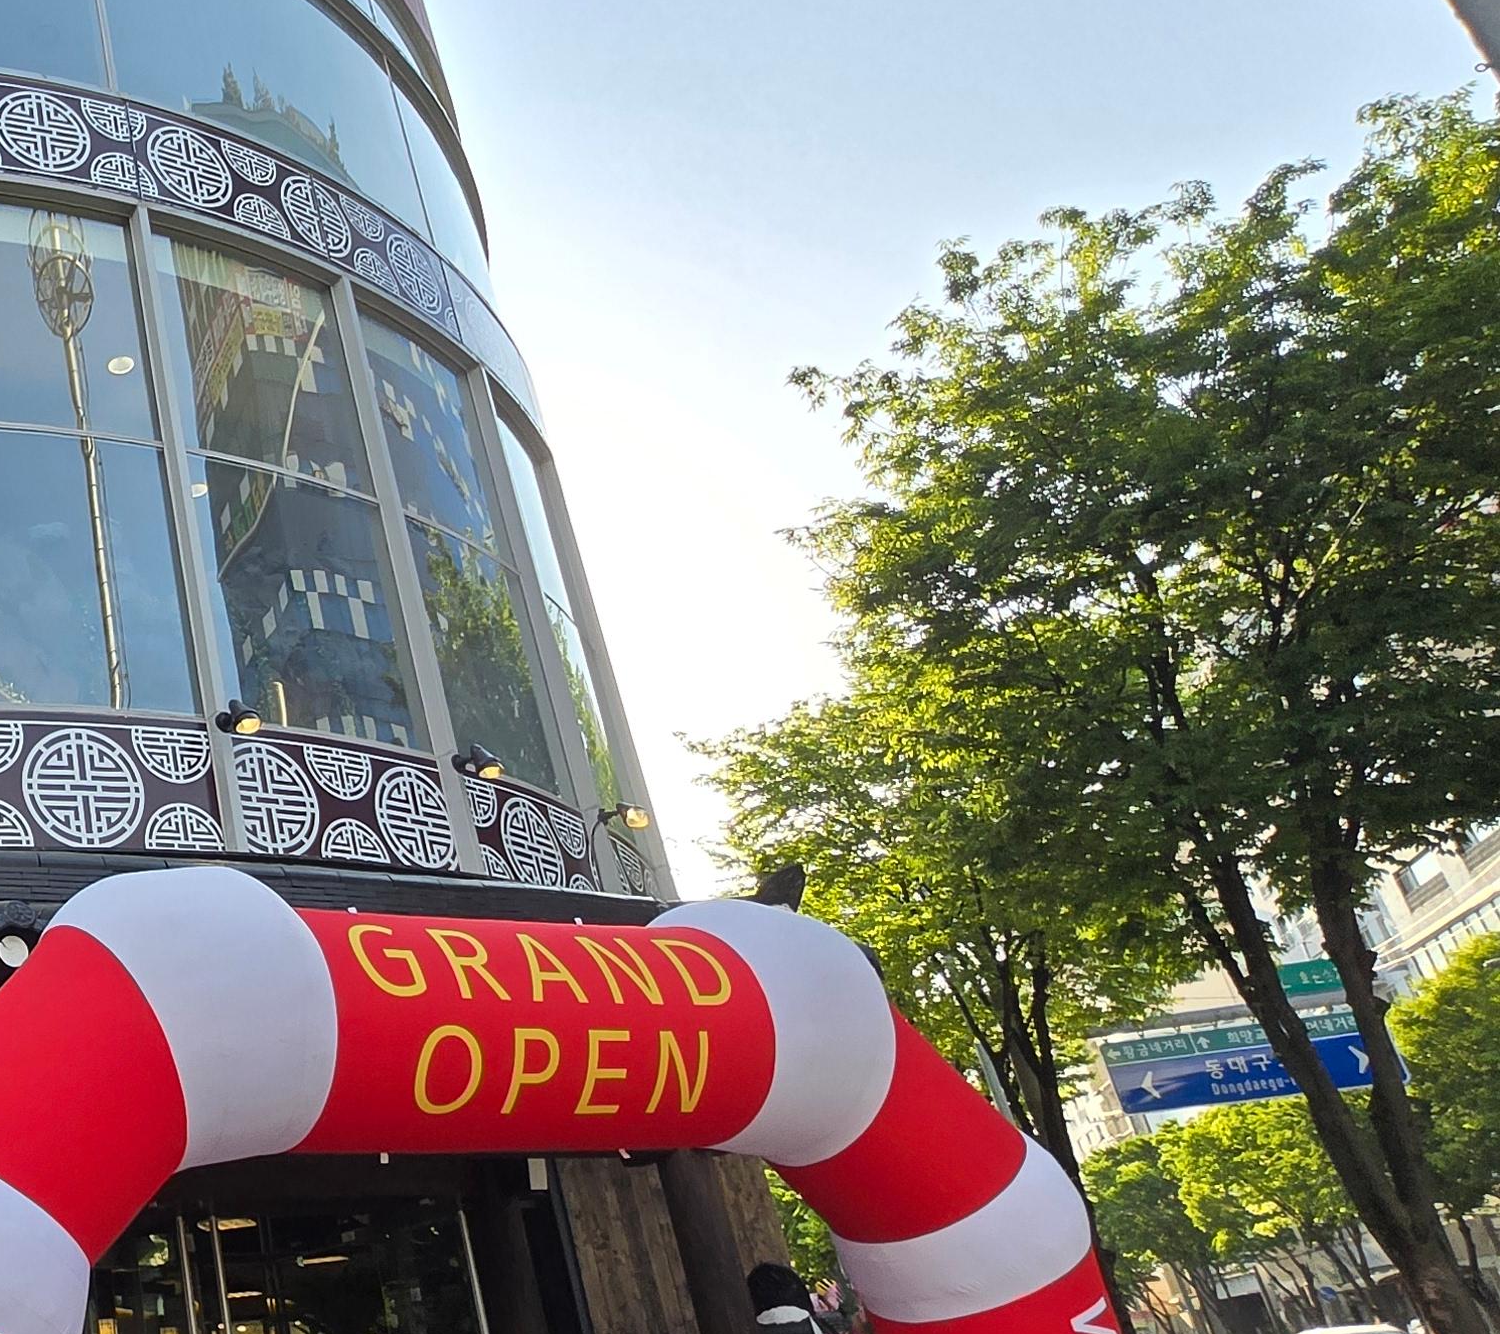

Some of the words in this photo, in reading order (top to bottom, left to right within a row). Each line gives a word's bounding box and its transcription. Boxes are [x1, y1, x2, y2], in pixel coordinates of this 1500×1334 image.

[347, 924, 732, 1006] GRAND
[414, 1025, 709, 1114] OPEN
[1205, 1053, 1284, 1080] 동대구
